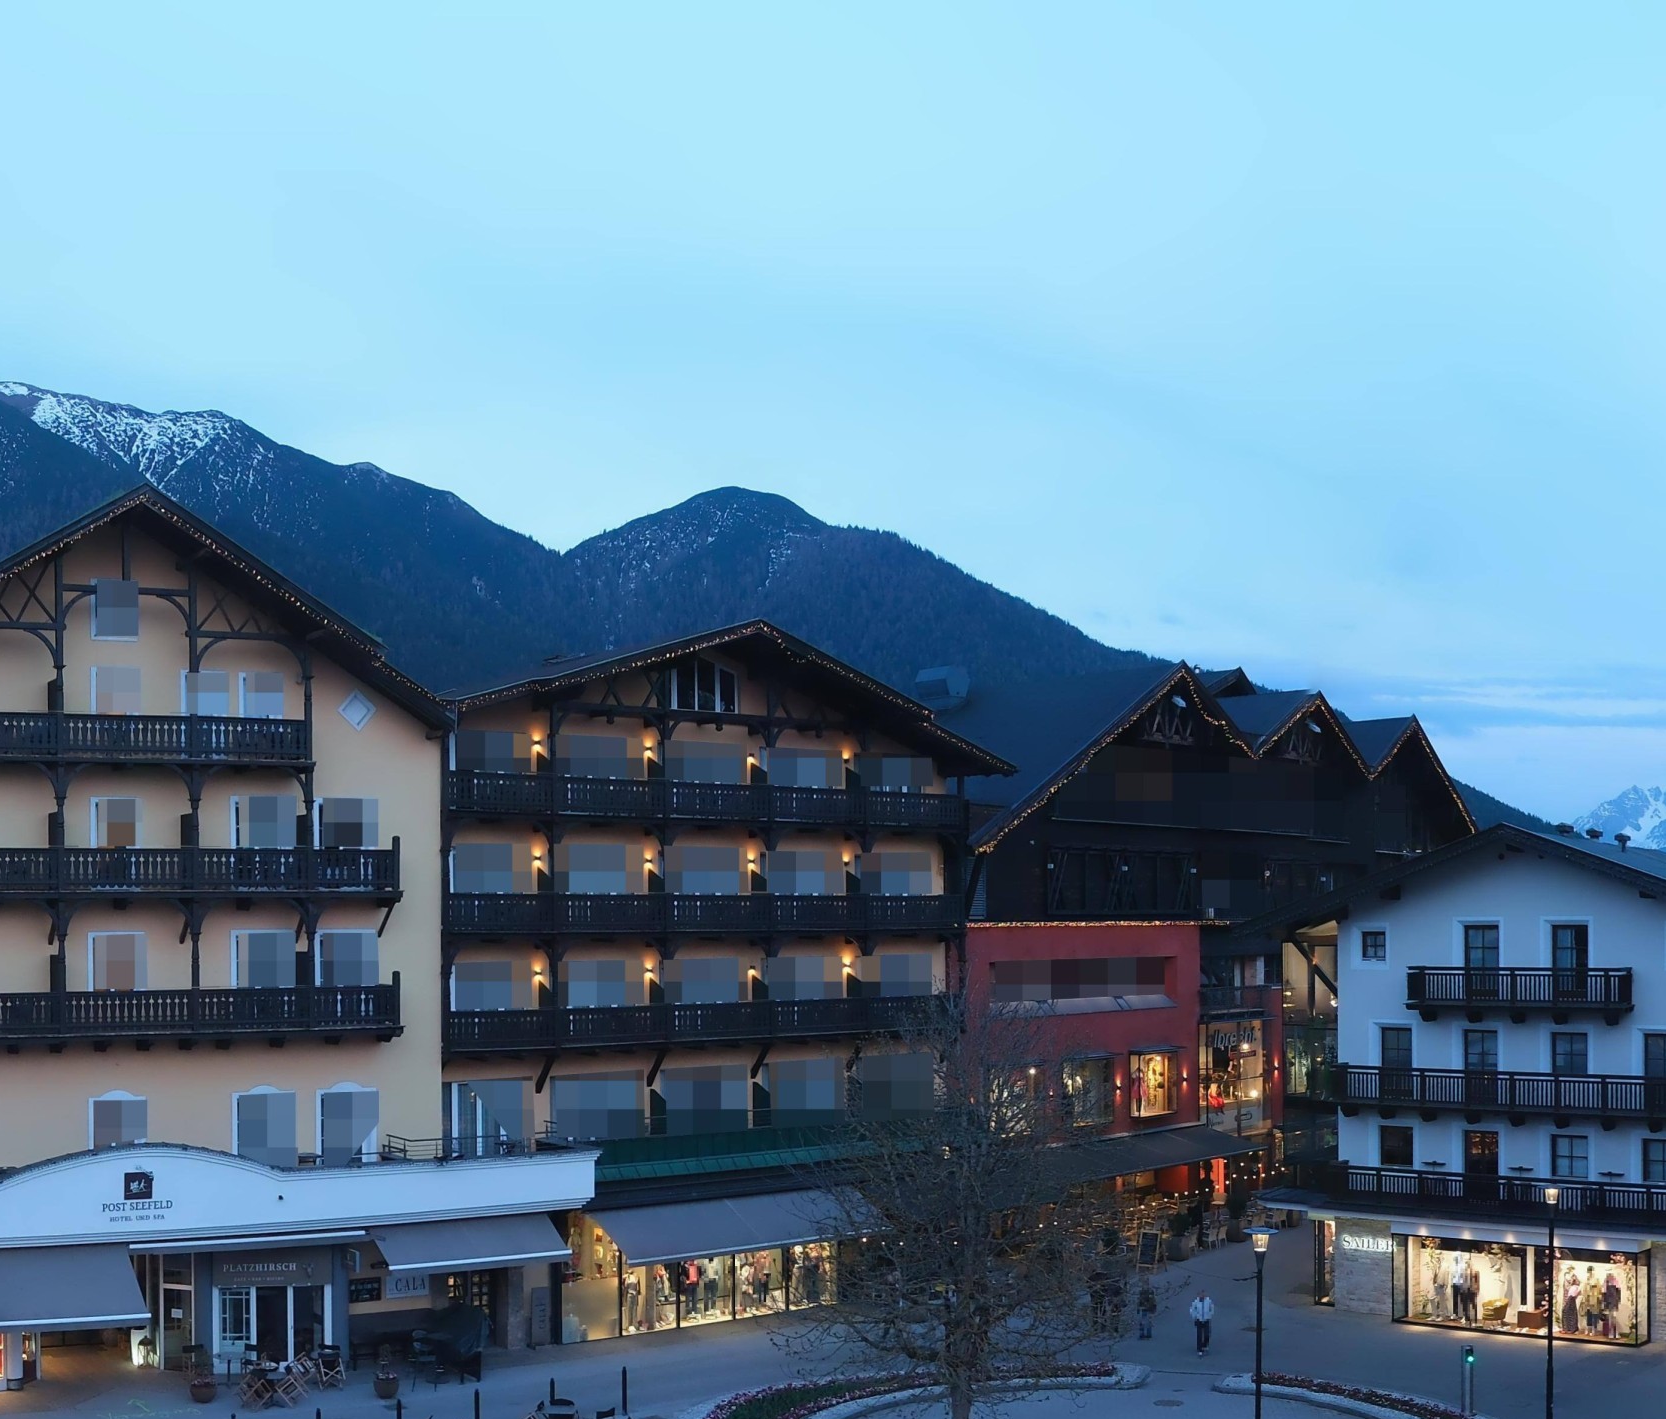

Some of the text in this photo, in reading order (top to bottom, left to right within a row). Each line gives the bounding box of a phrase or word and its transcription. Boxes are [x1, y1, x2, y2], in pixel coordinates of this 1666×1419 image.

[102, 1200, 173, 1212] POST SEEFELD
[1342, 1235, 1396, 1252] SAILER
[223, 1263, 297, 1273] PLATZHIRSCH
[395, 1276, 426, 1292] CALA
